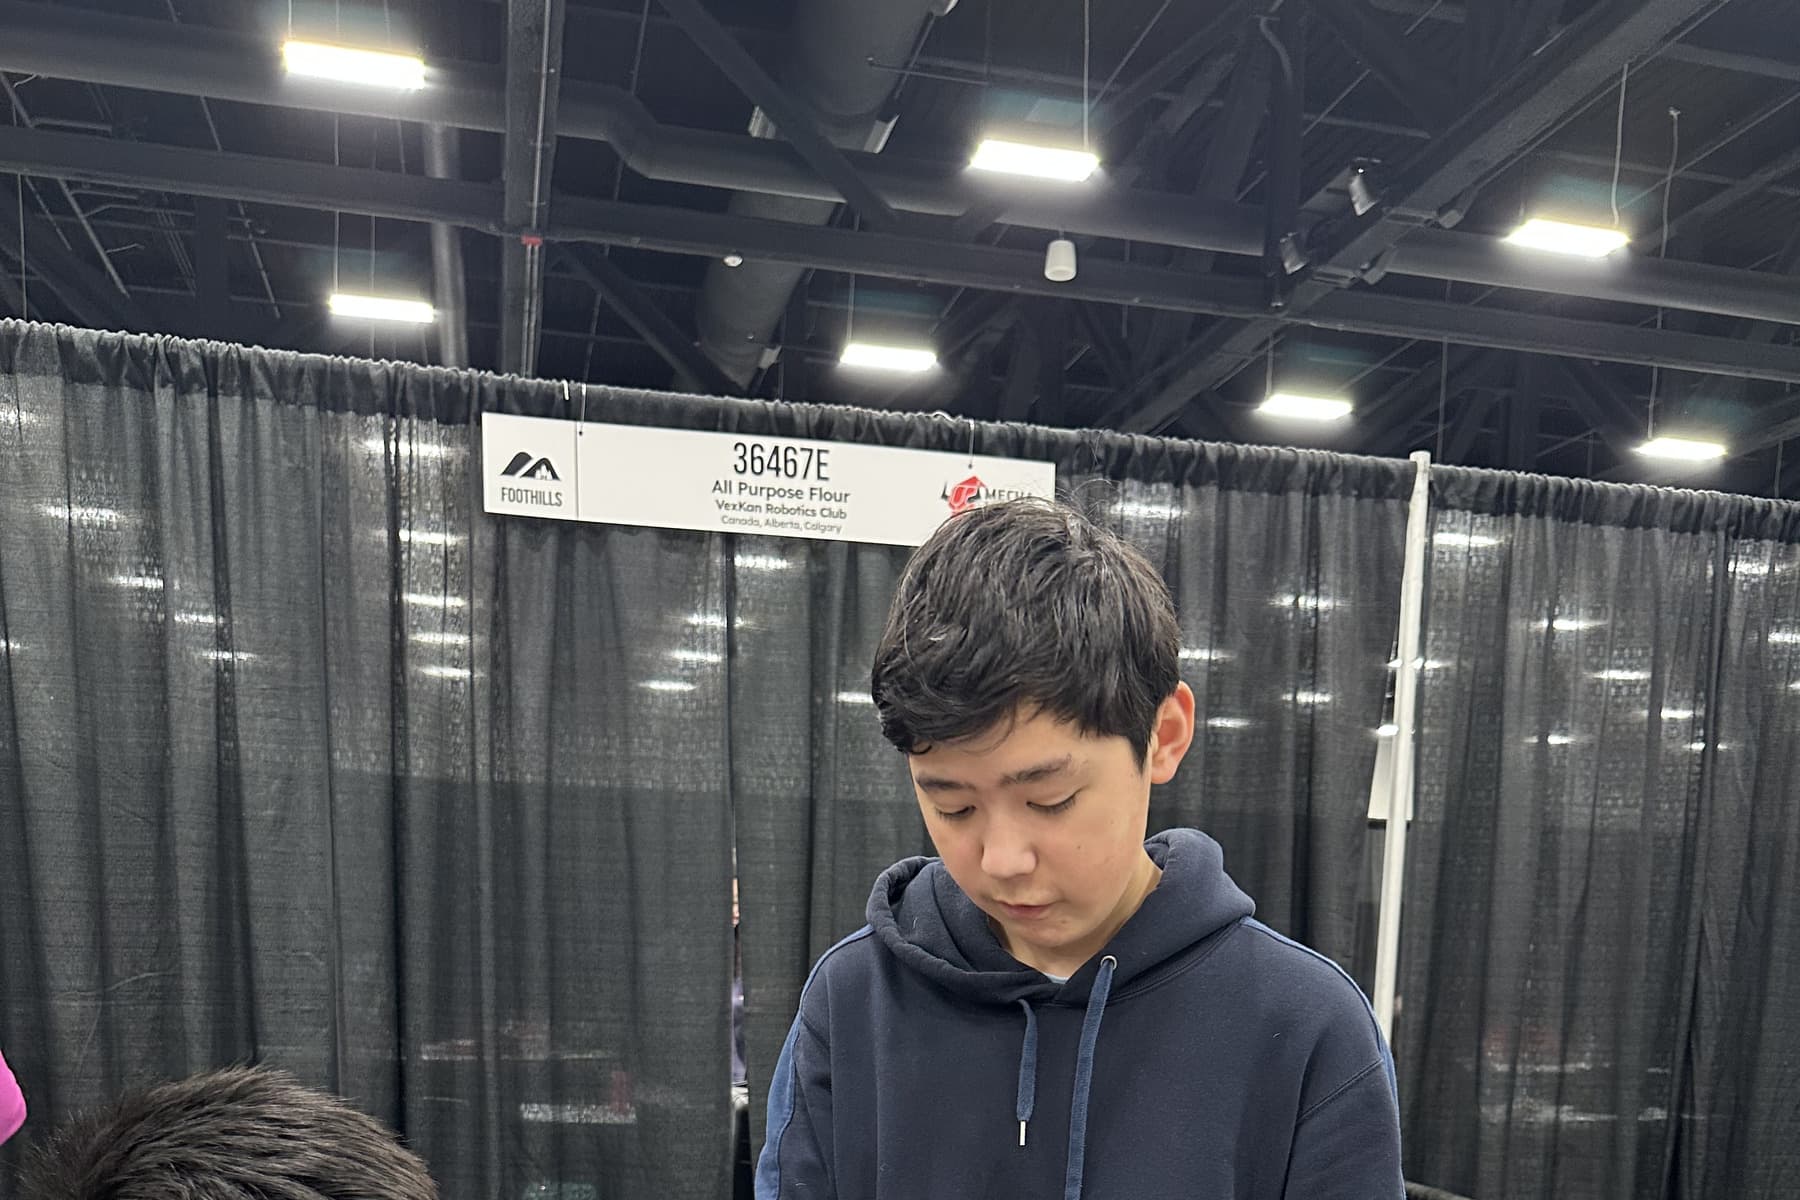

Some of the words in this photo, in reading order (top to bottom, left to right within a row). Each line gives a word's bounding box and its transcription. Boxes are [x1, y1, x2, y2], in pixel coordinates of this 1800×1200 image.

[733, 441, 830, 481] 36467E
[501, 486, 563, 507] FOOTHILLS
[711, 479, 732, 495] All
[738, 481, 804, 501] Purpose
[809, 487, 850, 504] Flour
[715, 499, 762, 514] VexKan
[765, 503, 817, 518] Robotics
[819, 507, 847, 520] Club
[721, 515, 763, 528] Canada,
[764, 518, 803, 532] Alberta,
[804, 521, 842, 534] Calgary
